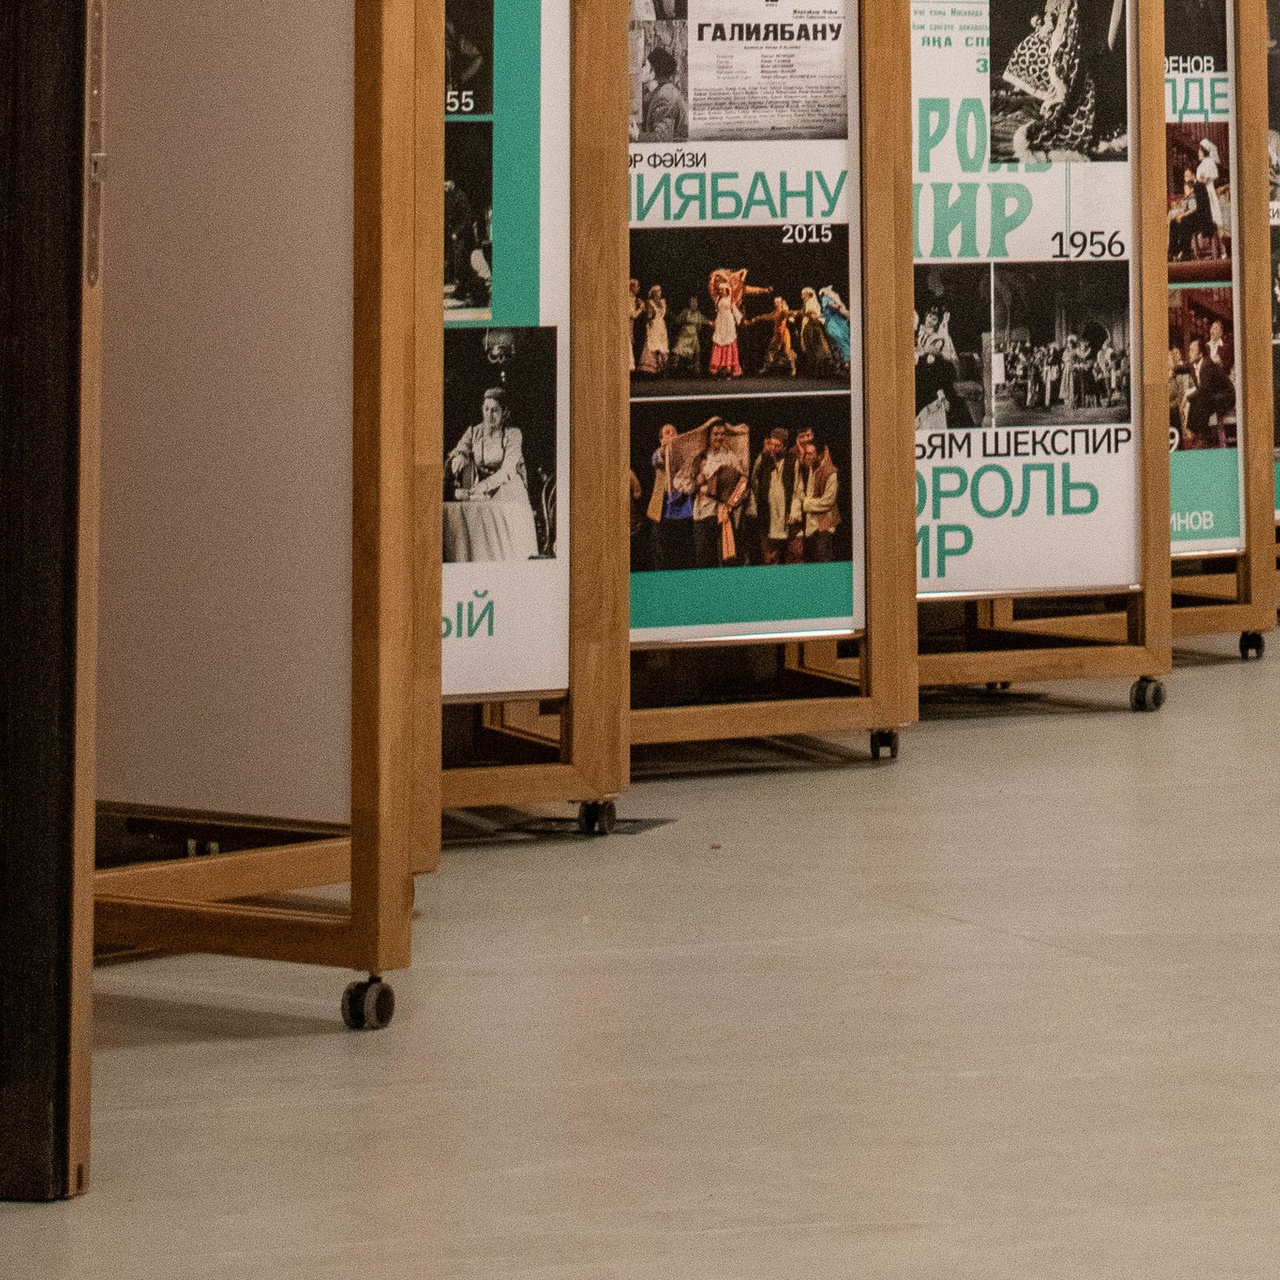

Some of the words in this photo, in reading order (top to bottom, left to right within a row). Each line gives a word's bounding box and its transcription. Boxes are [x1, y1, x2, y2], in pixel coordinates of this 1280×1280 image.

[697, 23, 843, 42] ГАЛИЯБАНУ
[921, 36, 952, 49] ЯҢА
[446, 90, 475, 112] 55
[647, 148, 708, 169] ФӘЙЗИ
[629, 170, 848, 222] ИЯБАНУ
[782, 224, 833, 243] 2015
[1050, 230, 1126, 259] 1956
[982, 427, 1133, 458] ШЕКСПИР
